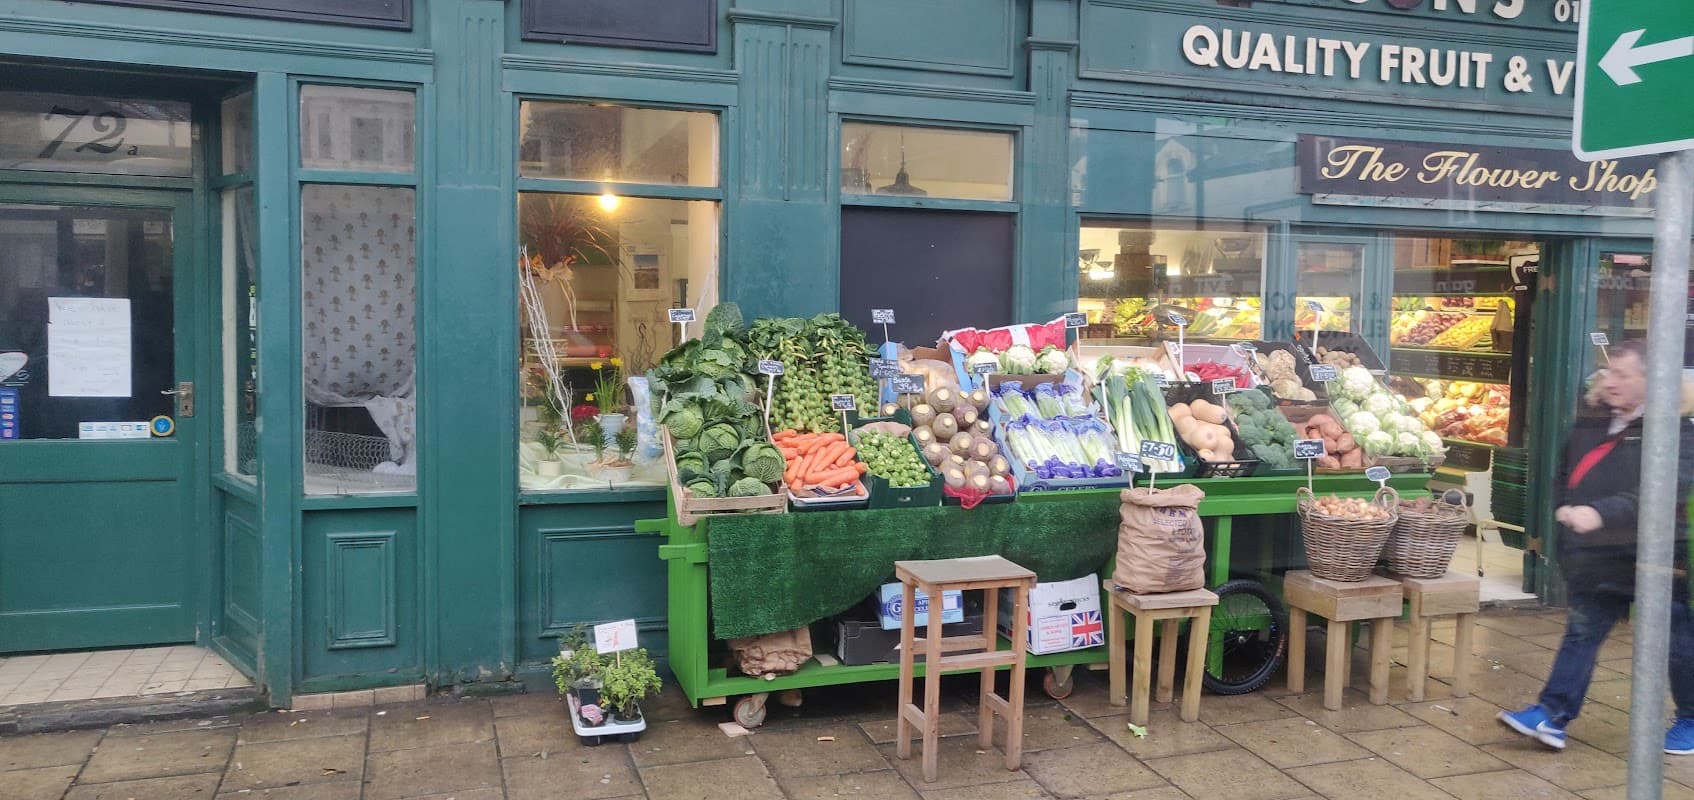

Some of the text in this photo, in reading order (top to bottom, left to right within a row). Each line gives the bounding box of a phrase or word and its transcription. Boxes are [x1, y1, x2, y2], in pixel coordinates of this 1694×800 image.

[1554, 0, 1579, 23] 01
[1183, 25, 1575, 95] QUALITY FRUIT & V
[1321, 145, 1657, 200] The Flower Shop
[1523, 266, 1540, 274] FRE
[891, 602, 903, 613] G
